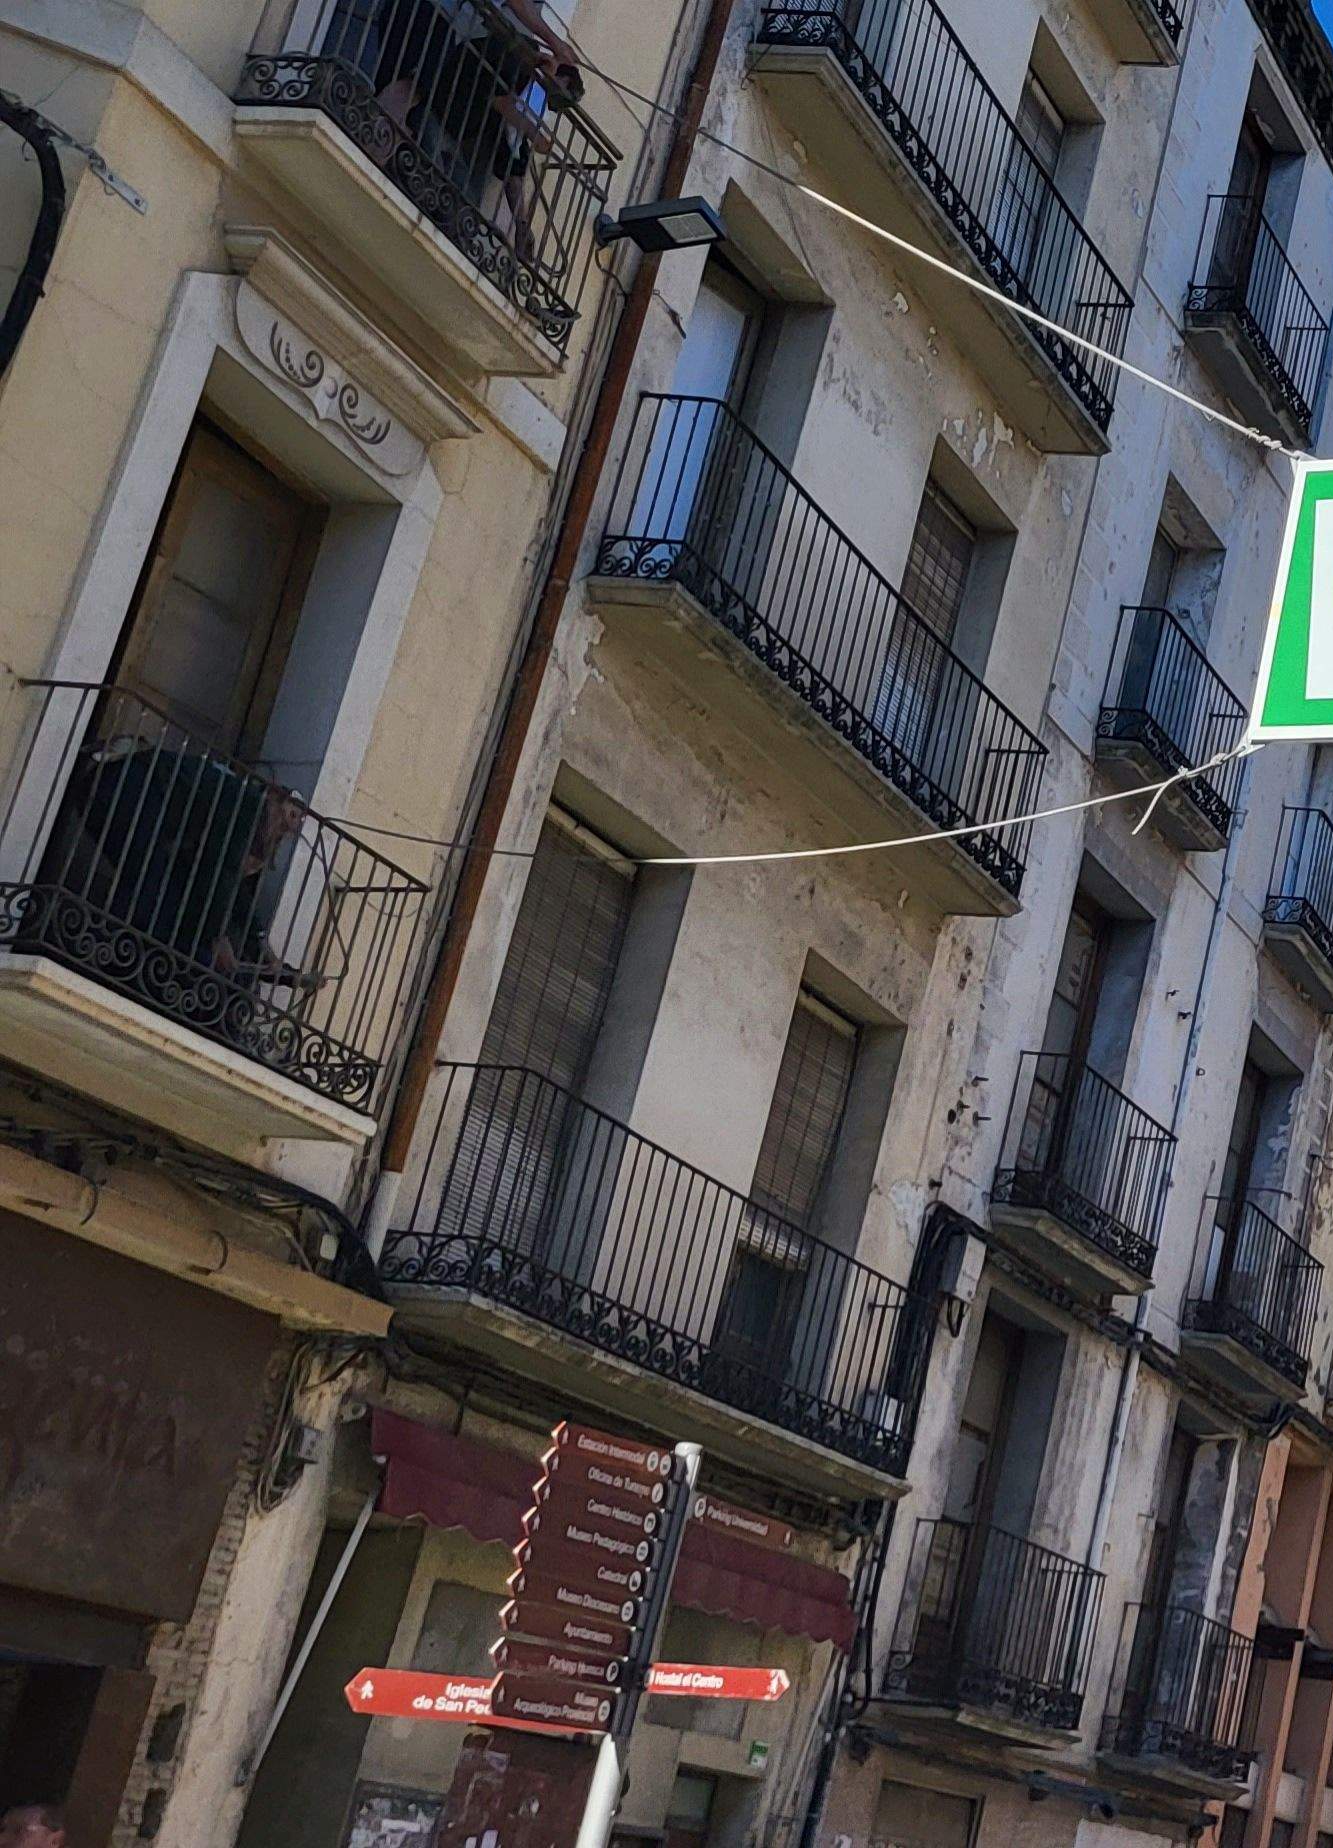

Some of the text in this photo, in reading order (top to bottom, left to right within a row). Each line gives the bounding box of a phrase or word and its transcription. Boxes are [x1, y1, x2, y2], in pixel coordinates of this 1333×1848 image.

[548, 1654, 578, 1675] Parking
[654, 1671, 683, 1687] Hostal
[691, 1672, 724, 1689] Centro
[412, 1694, 434, 1710] de
[434, 1696, 464, 1712] San
